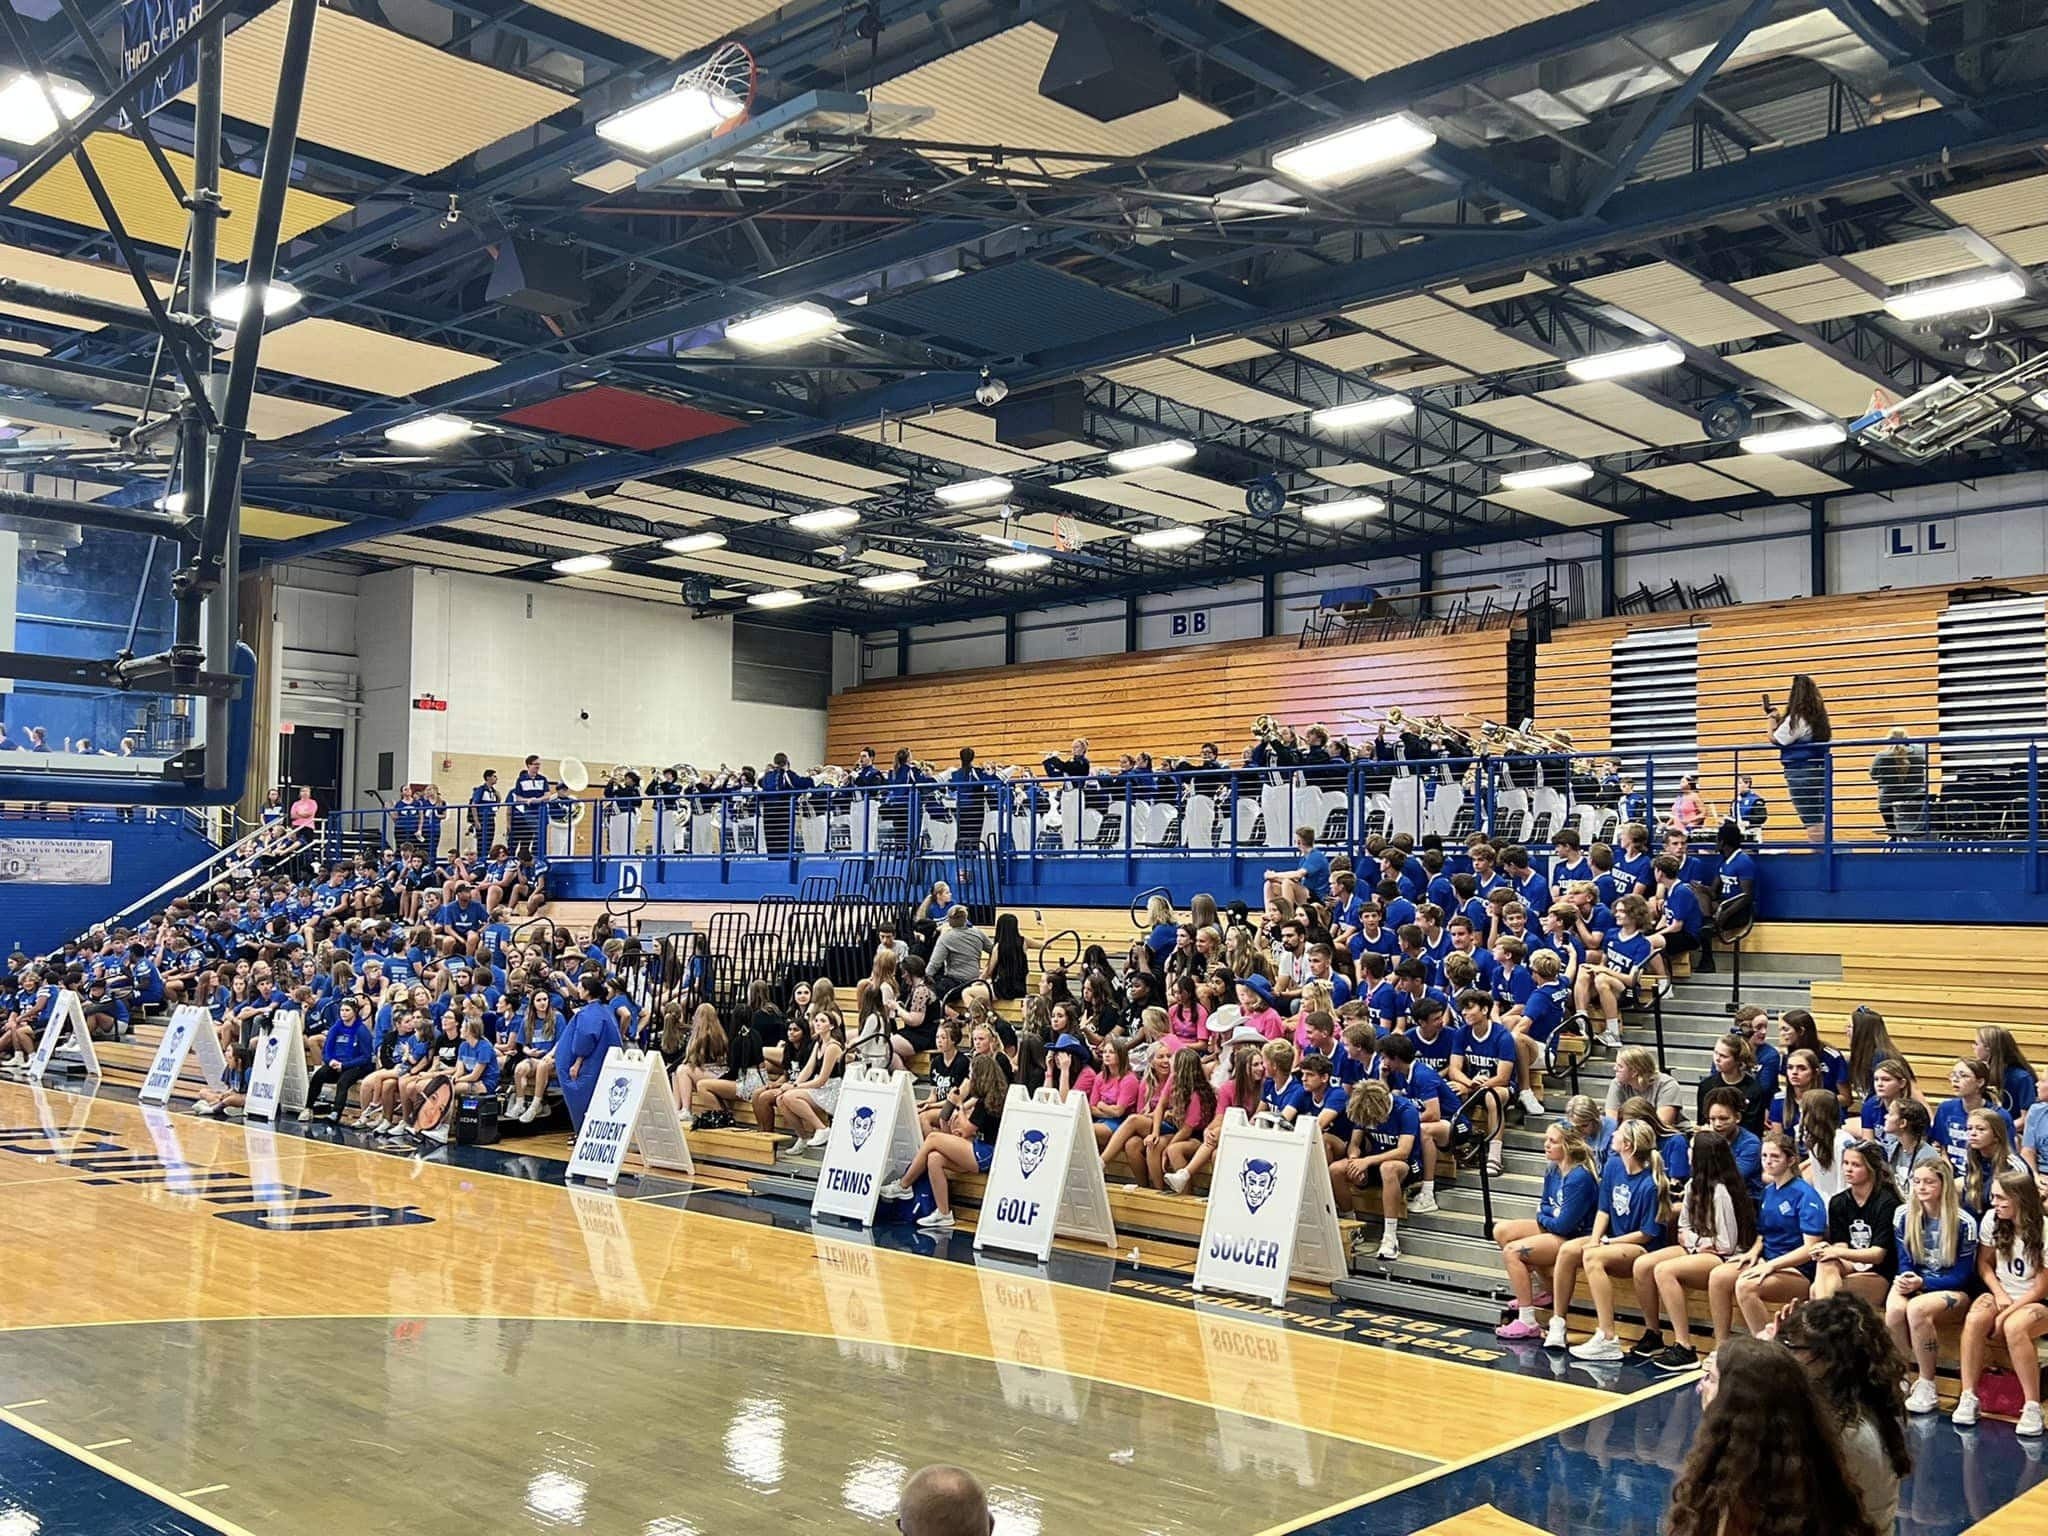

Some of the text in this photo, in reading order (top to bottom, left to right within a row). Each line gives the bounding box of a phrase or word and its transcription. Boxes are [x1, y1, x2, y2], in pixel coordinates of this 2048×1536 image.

[1172, 612, 1206, 635] BB
[623, 865, 638, 894] D
[586, 1119, 627, 1142] STUDENT
[578, 1141, 618, 1164] COUNCIL
[826, 1168, 873, 1196] TENNIS
[996, 1196, 1041, 1227] GOLF
[1209, 1231, 1279, 1270] SOCCER
[1111, 1278, 1355, 1334] Champions
[1336, 1308, 1473, 1340] 1934
[1357, 1326, 1508, 1363] State
